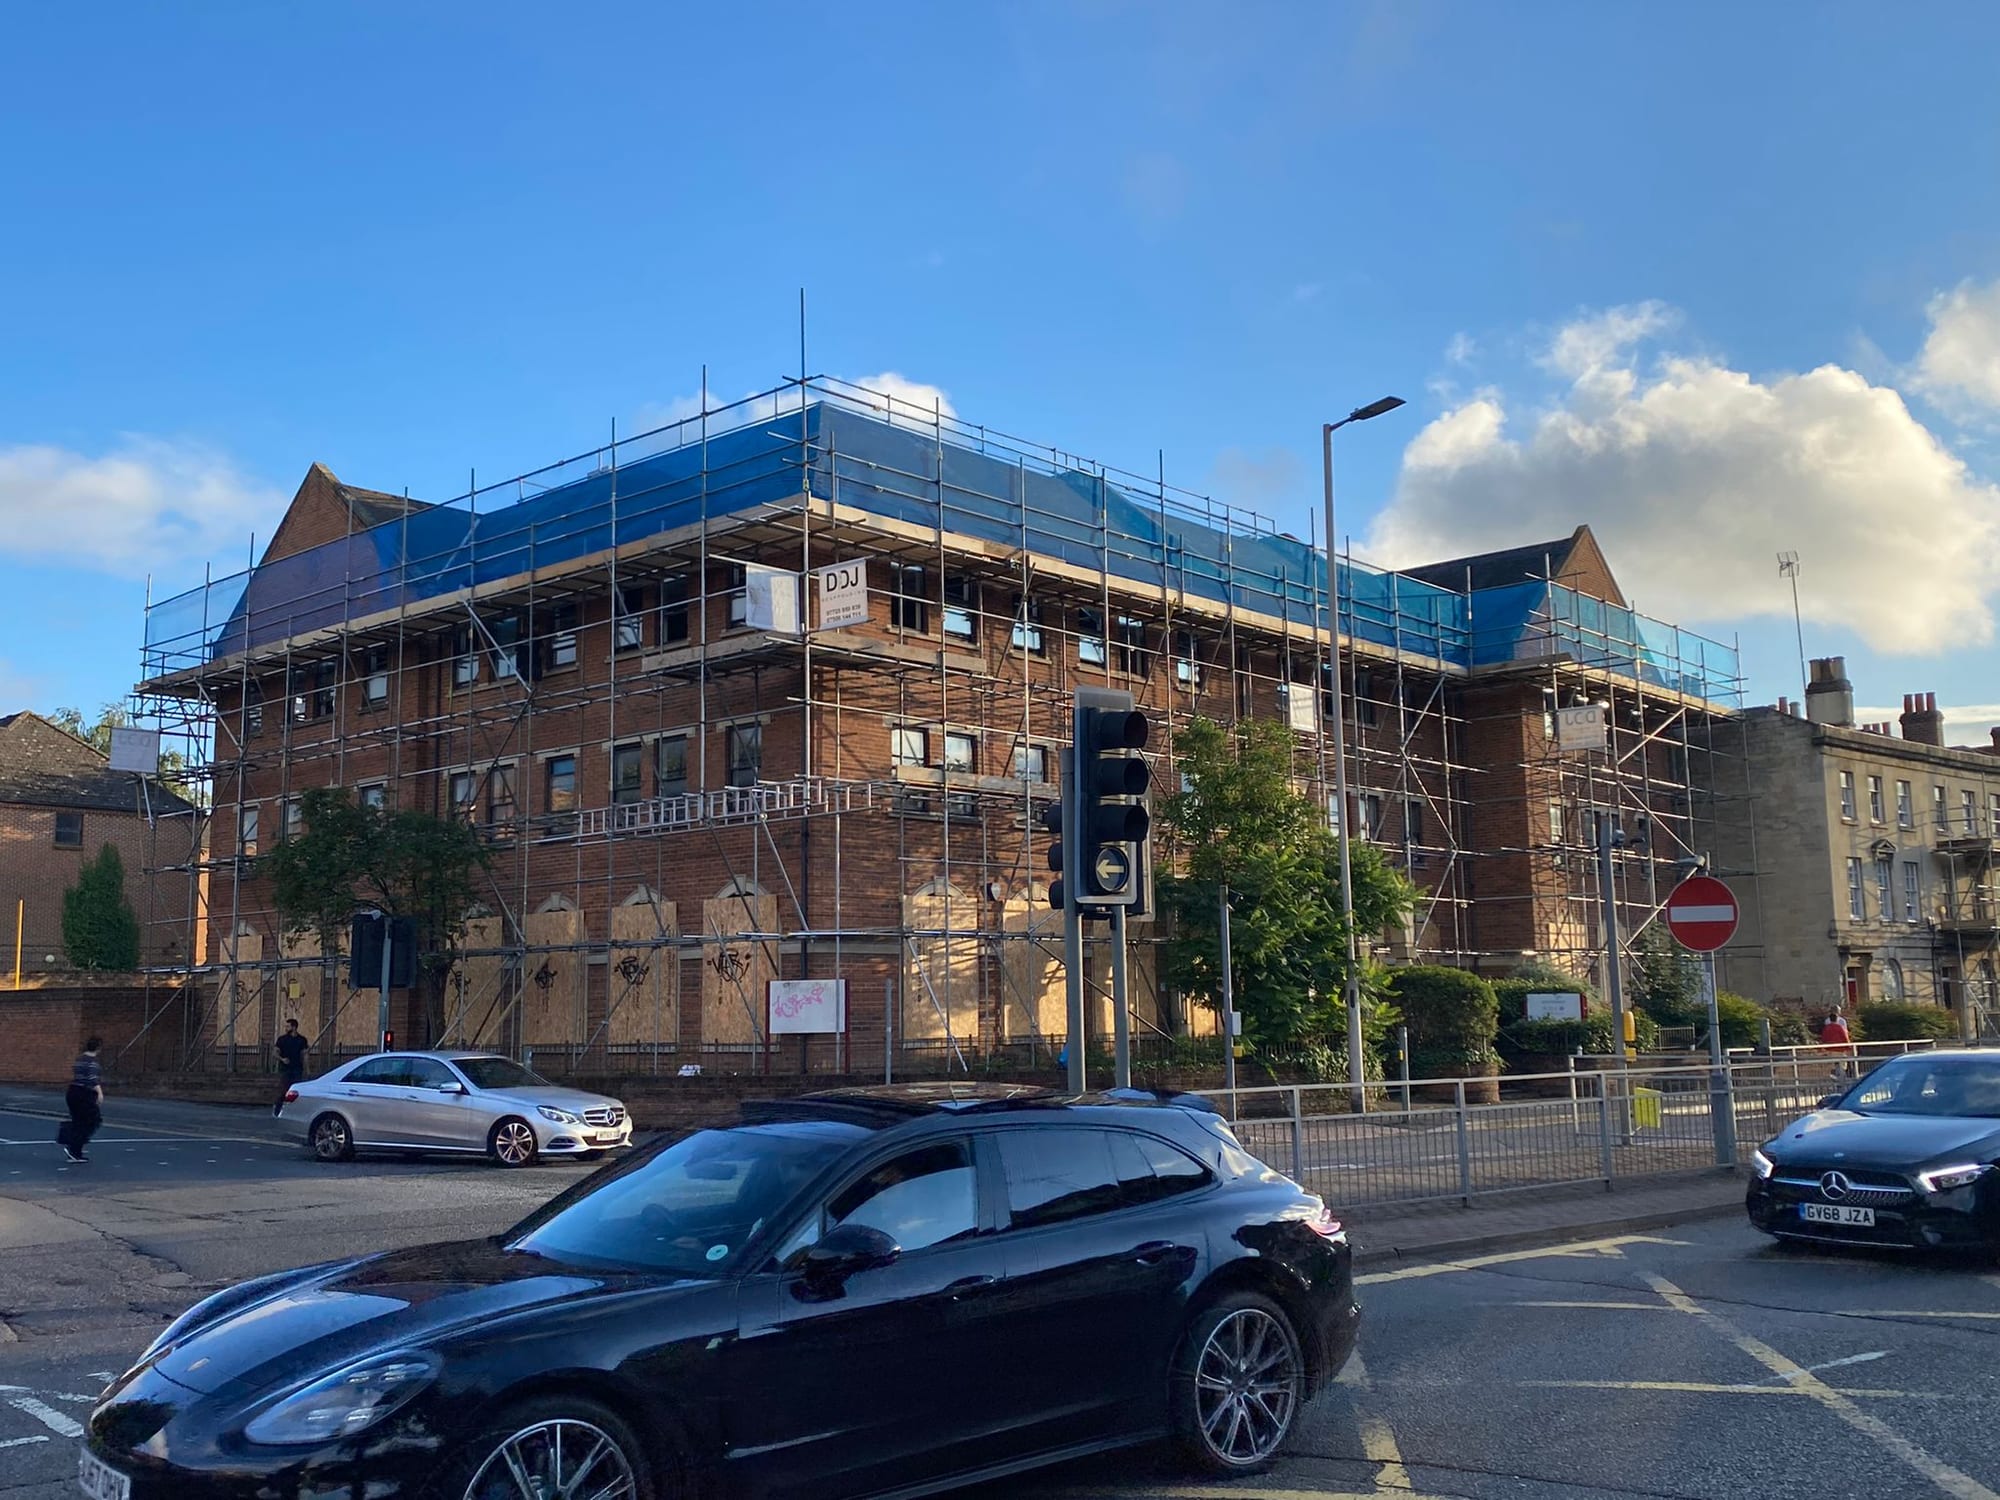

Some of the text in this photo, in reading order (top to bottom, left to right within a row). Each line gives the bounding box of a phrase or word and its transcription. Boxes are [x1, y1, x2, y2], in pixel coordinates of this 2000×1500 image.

[826, 567, 858, 592] DDJ
[1807, 1205, 1871, 1224] GV68 JZA
